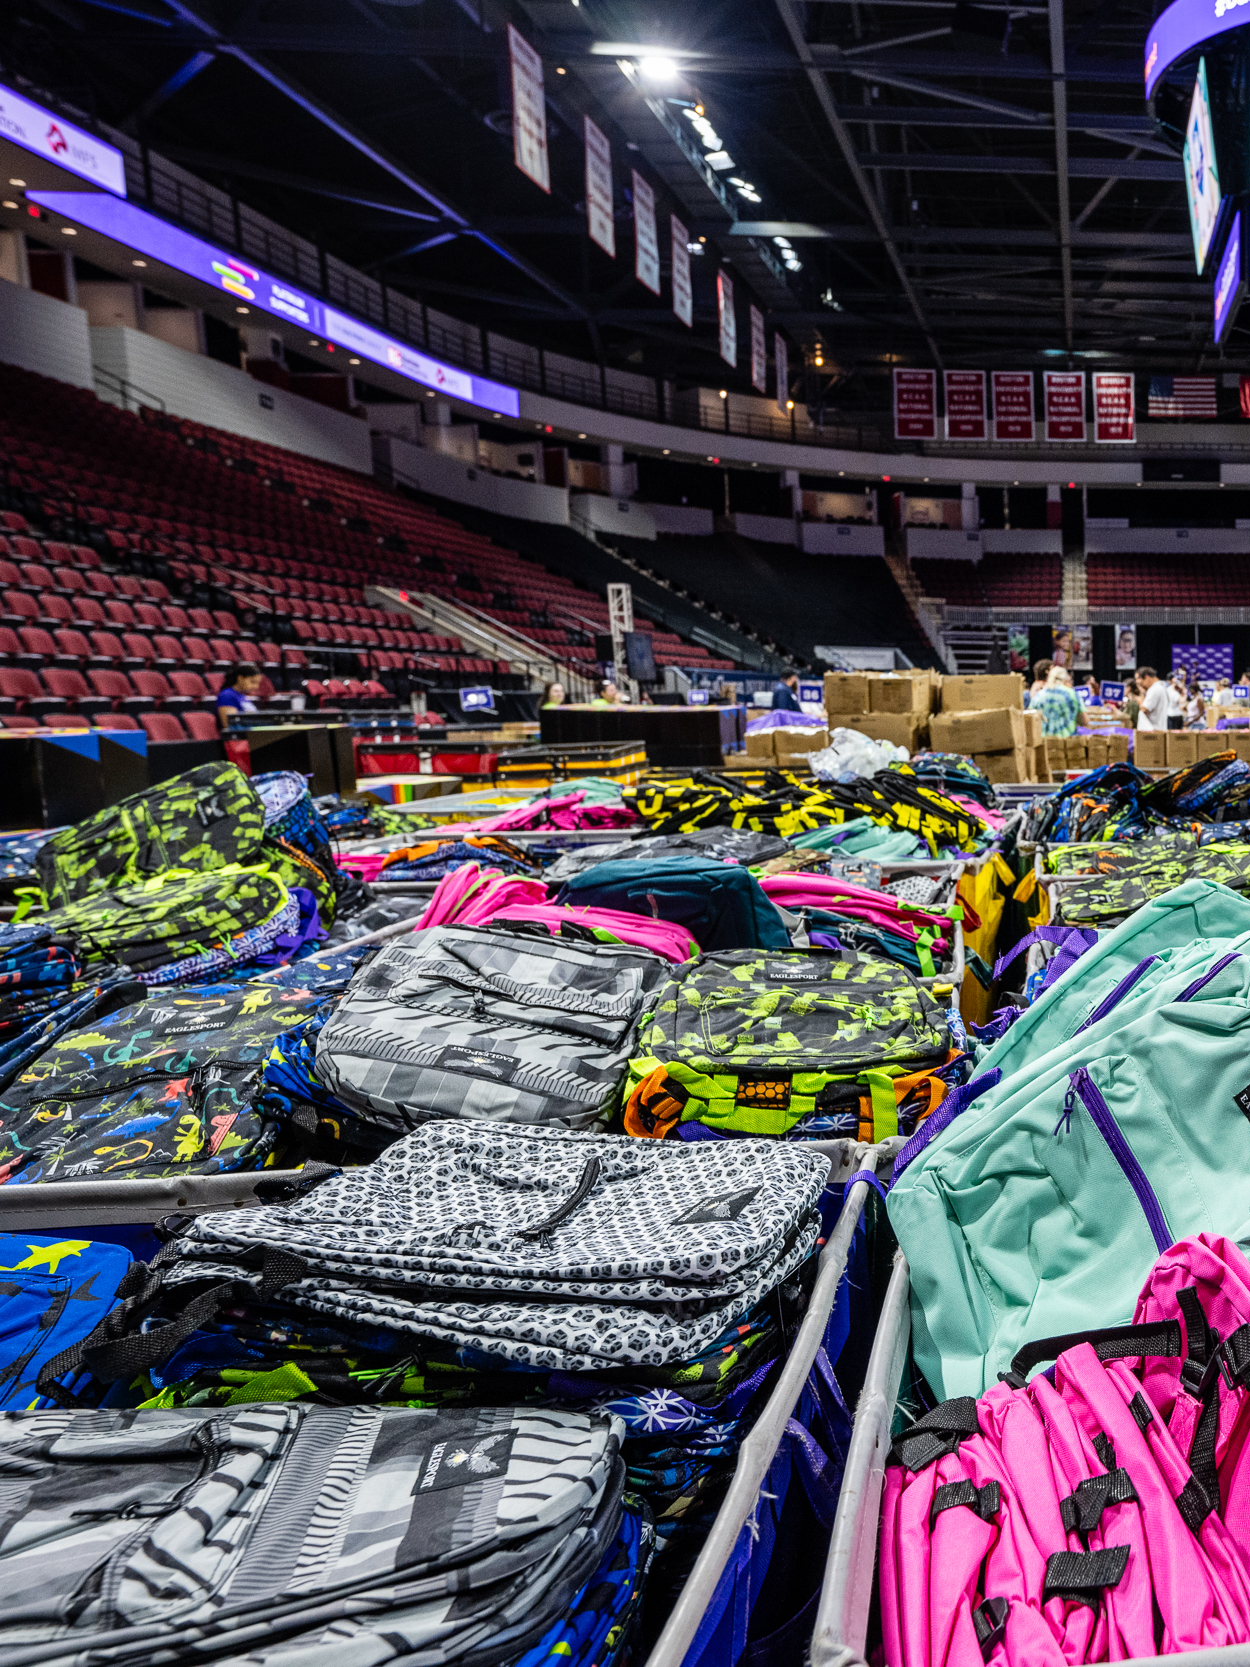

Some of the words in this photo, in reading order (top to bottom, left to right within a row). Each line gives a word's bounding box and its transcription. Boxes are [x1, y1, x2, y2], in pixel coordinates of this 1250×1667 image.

[803, 690, 820, 700] 36
[1104, 686, 1122, 698] 37
[164, 1021, 226, 1034] EAGLESPORT
[450, 1046, 515, 1063] EAGLESPORT
